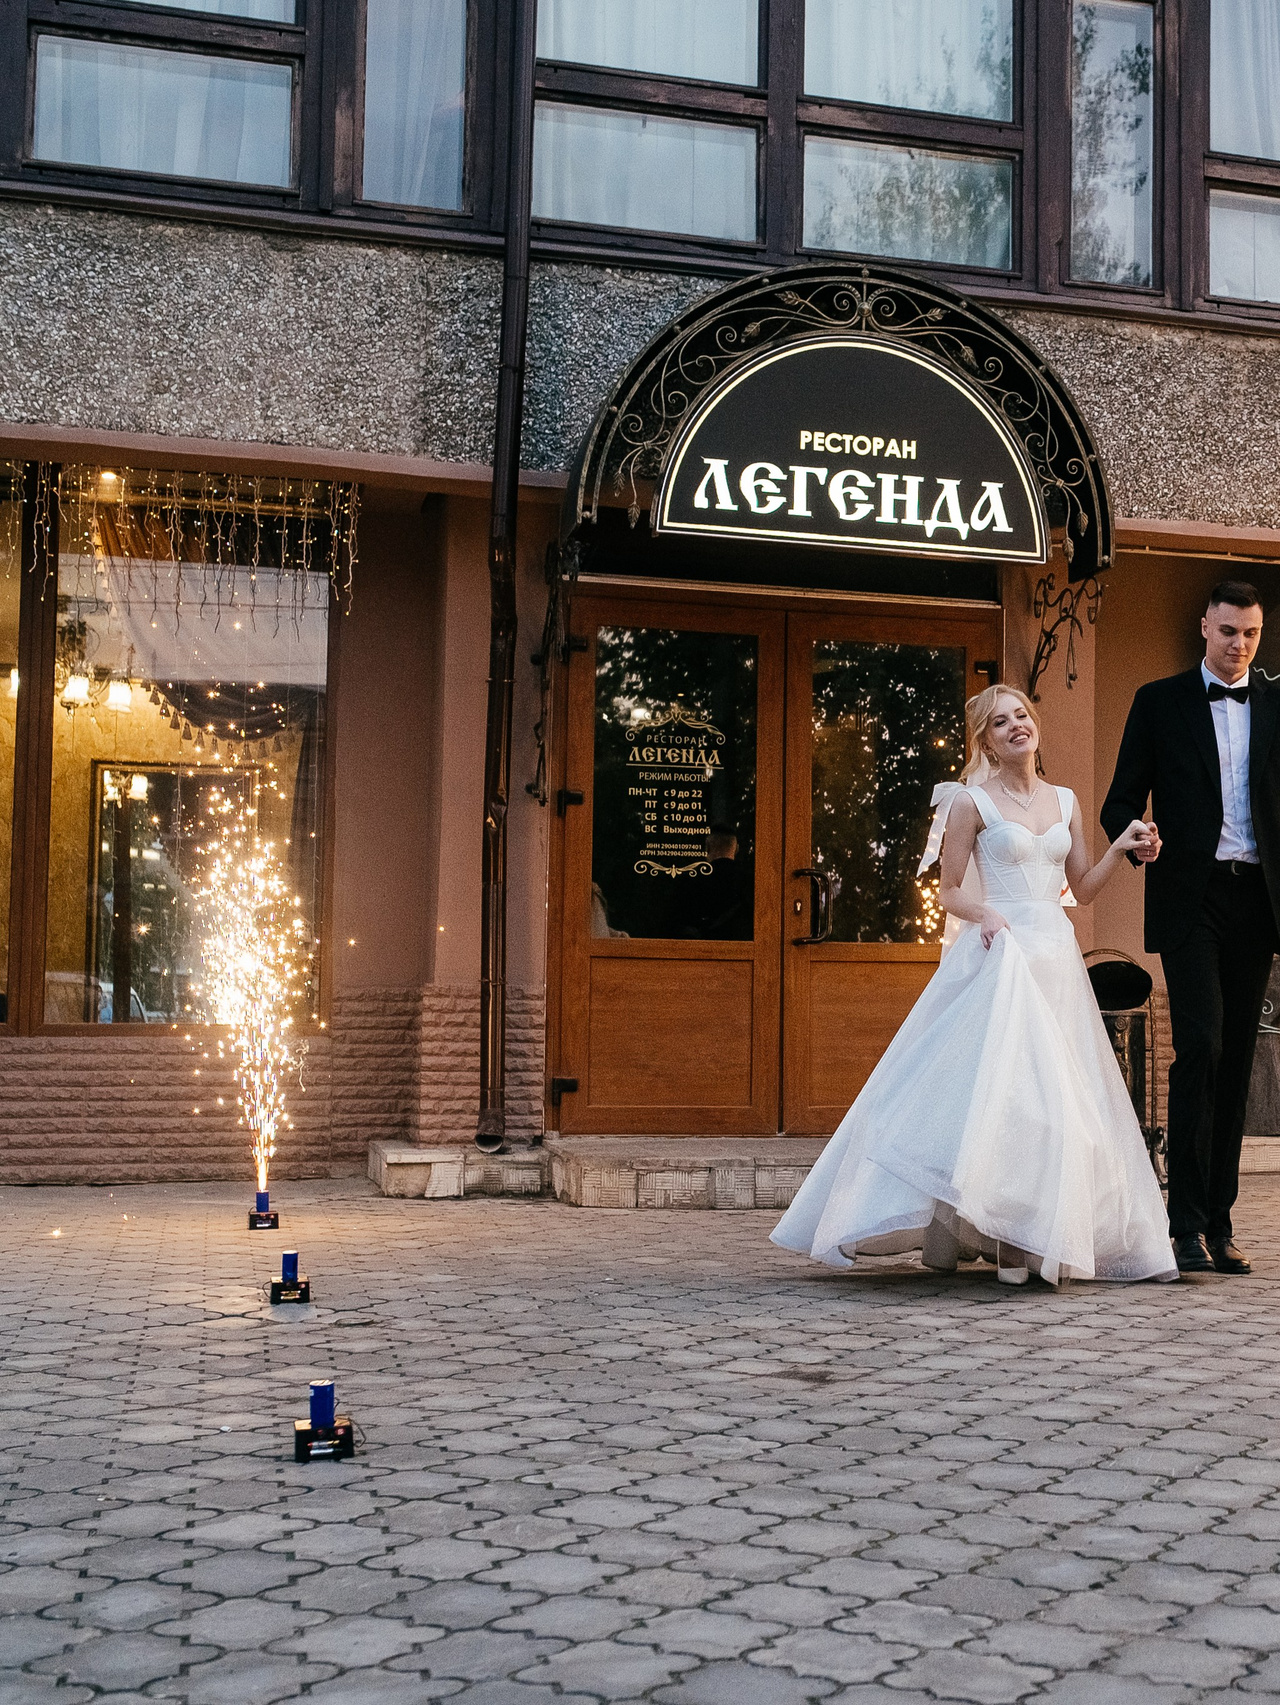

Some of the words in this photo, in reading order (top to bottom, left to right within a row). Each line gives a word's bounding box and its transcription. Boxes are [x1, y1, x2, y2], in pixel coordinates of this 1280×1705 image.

[800, 430, 917, 460] РЕСТОРАН
[693, 456, 1014, 541] ЛЕГЕНДА
[646, 735, 706, 745] РЕСТОРАН
[629, 747, 721, 766] ЛЕГЕНДА
[639, 771, 672, 781] РЕЖИМ
[628, 787, 658, 796] ПН-ЧТ
[670, 789, 676, 797] 9
[677, 791, 690, 799] до
[691, 790, 703, 798] 22
[645, 801, 657, 809] ПТ
[670, 801, 676, 809] 9
[691, 802, 702, 810] 01
[645, 813, 657, 821] СБ
[645, 825, 657, 833] ВС
[664, 826, 711, 835] Выходной
